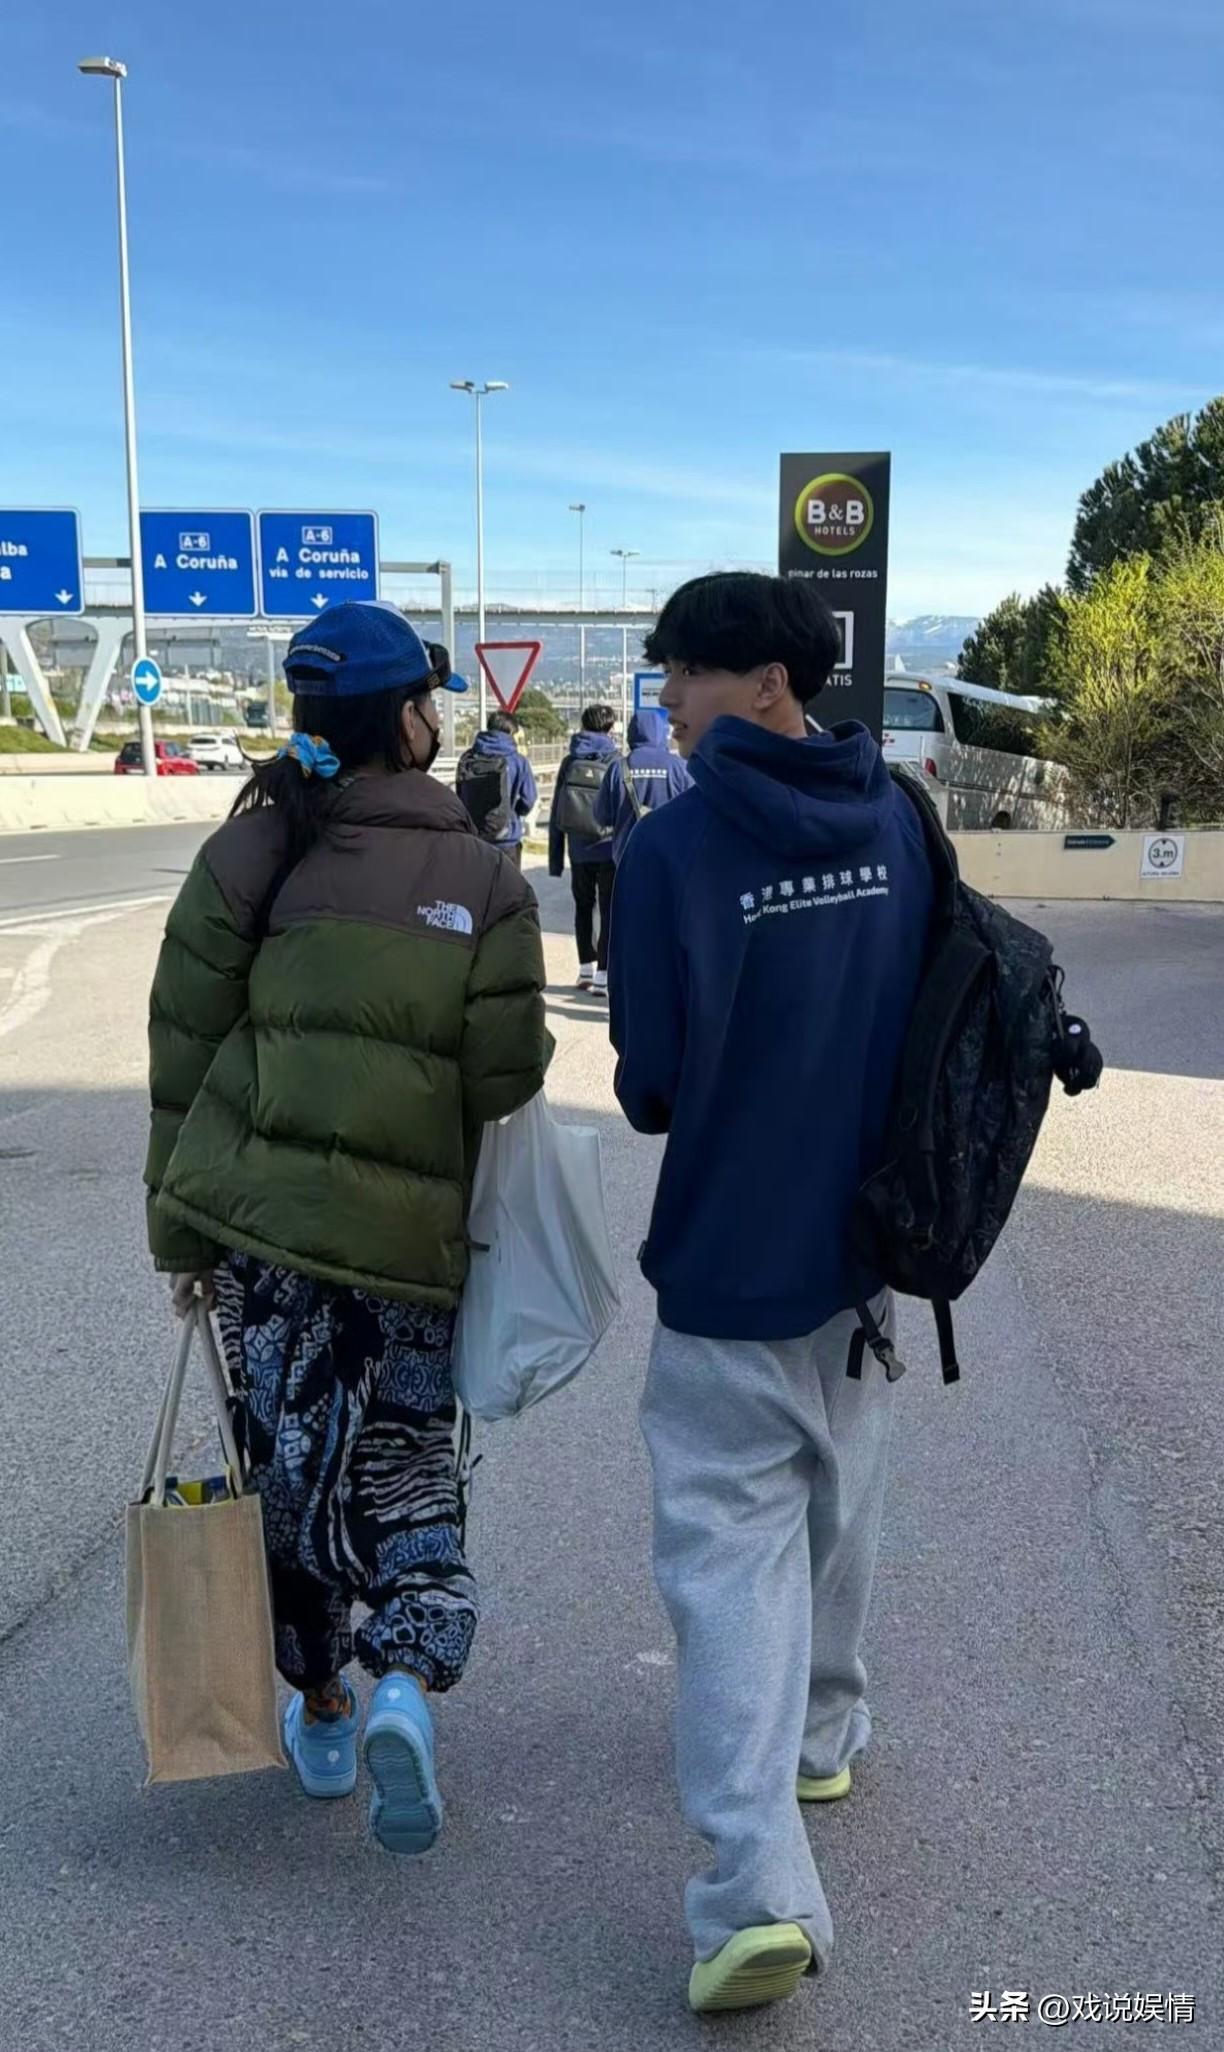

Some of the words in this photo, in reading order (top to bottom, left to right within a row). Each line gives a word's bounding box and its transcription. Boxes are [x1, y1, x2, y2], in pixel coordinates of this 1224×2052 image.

[808, 499, 865, 525] B&B
[305, 528, 330, 542] A-6
[814, 526, 856, 536] HOTELS
[0, 540, 28, 557] lba
[183, 535, 208, 549] A-6
[154, 553, 168, 569] A
[176, 553, 239, 569] Coruña
[276, 547, 289, 562] A
[298, 547, 361, 563] Coruña
[295, 567, 312, 579] de
[318, 567, 369, 580] servicio
[816, 568, 830, 579] de
[832, 568, 847, 579] las
[850, 569, 878, 579] rozas
[824, 673, 853, 687] ATIS
[762, 900, 789, 914] Kong
[789, 897, 813, 911] Elite
[812, 890, 856, 906] Volleyball
